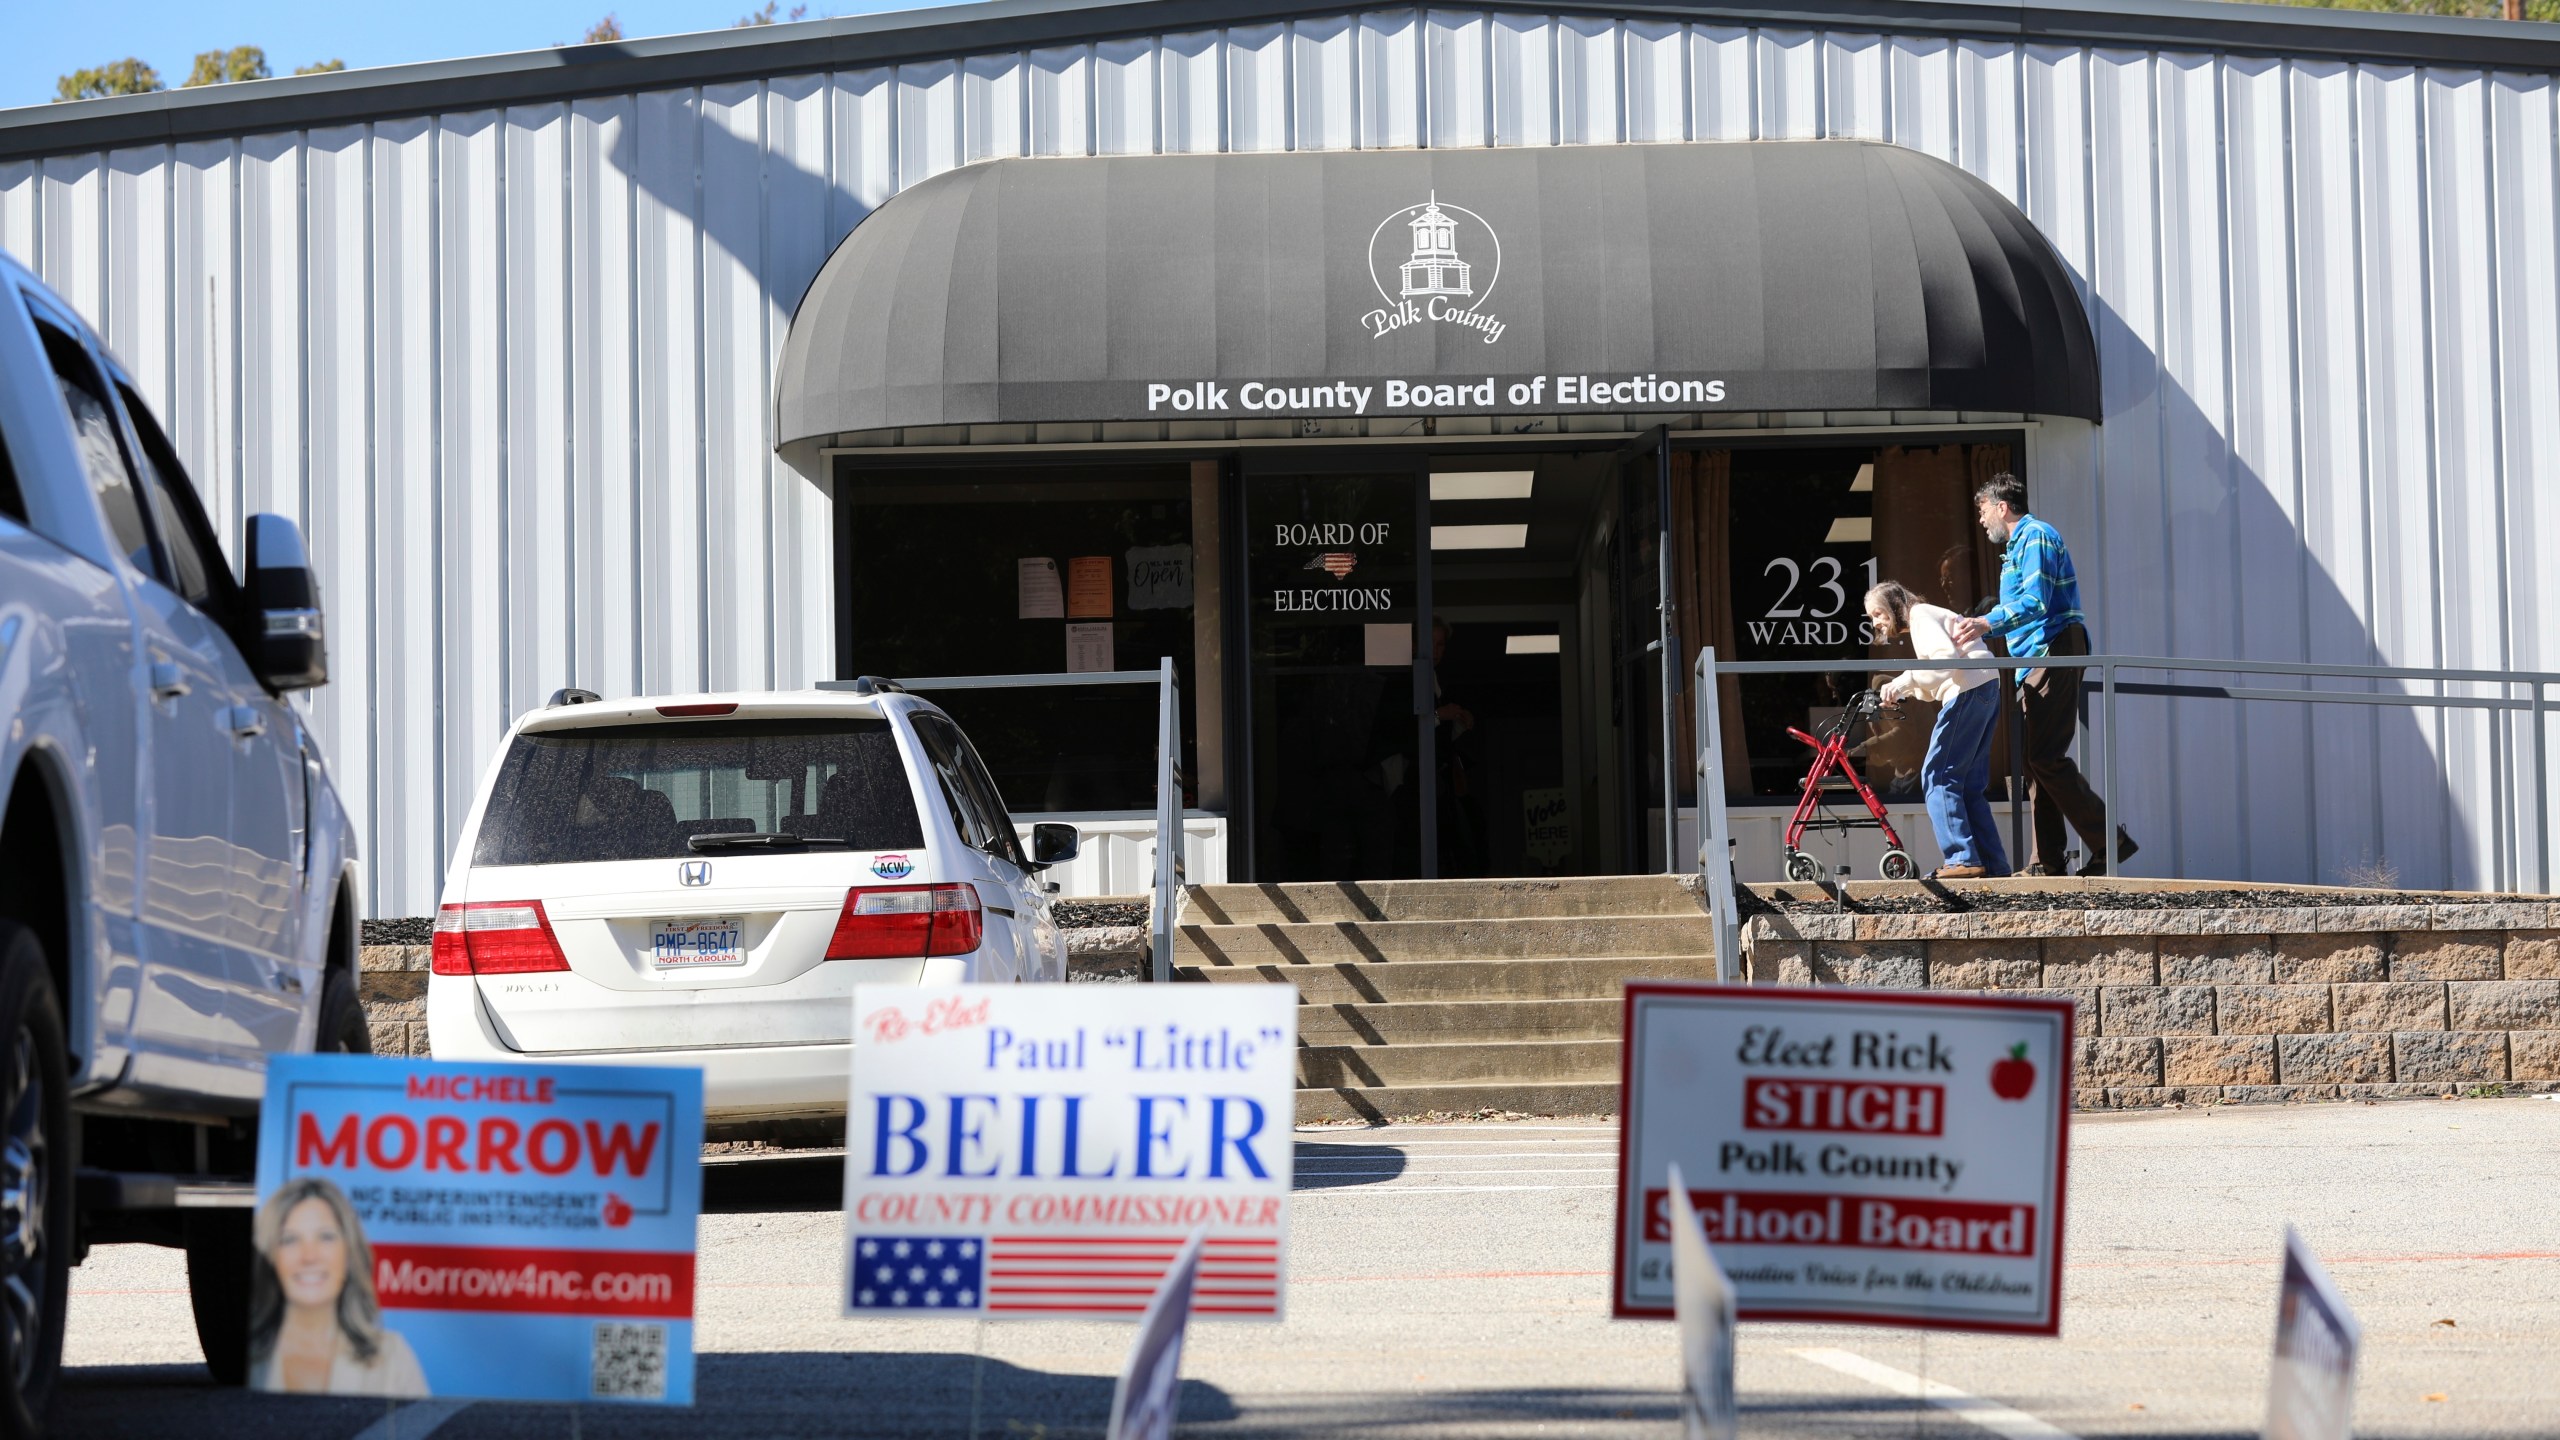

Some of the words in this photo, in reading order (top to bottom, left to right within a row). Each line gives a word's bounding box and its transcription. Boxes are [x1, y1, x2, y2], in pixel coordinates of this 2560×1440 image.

[1361, 300, 1422, 340] Polk
[1428, 296, 1507, 345] County
[1148, 382, 1229, 411] Polk
[1239, 380, 1372, 414] County
[1385, 377, 1495, 408] Board
[1507, 375, 1545, 406] of
[1556, 373, 1725, 405] Elections
[1275, 524, 1354, 546] BOARD
[1360, 523, 1390, 545] OF
[1134, 561, 1184, 595] Open
[1763, 556, 1878, 618] 231
[1274, 588, 1391, 611] ELECTIONS
[1747, 621, 1848, 646] WARD
[1858, 621, 1904, 646] S.
[1527, 798, 1567, 826] Vote
[1528, 825, 1568, 841] HERE
[880, 861, 904, 874] ACW
[655, 930, 738, 957] PMP-8647
[658, 956, 690, 964] NORTH
[693, 954, 737, 963] CAROLINA
[864, 996, 991, 1044] Re-Elect
[985, 1027, 1086, 1071] Paul
[1737, 1025, 1838, 1068] Elect
[1850, 1031, 1954, 1074] Rick
[405, 1075, 556, 1105] MICHELE
[1755, 1082, 1936, 1132] STICH
[295, 1112, 661, 1179] MORROW
[866, 1093, 1274, 1180] BEILER
[1719, 1143, 1806, 1176] Polk
[1818, 1145, 1964, 1191] County
[391, 1187, 599, 1210] SUPERINTENDENT
[856, 1193, 1001, 1224] COUNTY
[1009, 1193, 1282, 1228] COMMISSIONER
[378, 1208, 451, 1227] PUBLIC
[1859, 1202, 2027, 1254] Board
[378, 1259, 672, 1302] Morrow4nc.com
